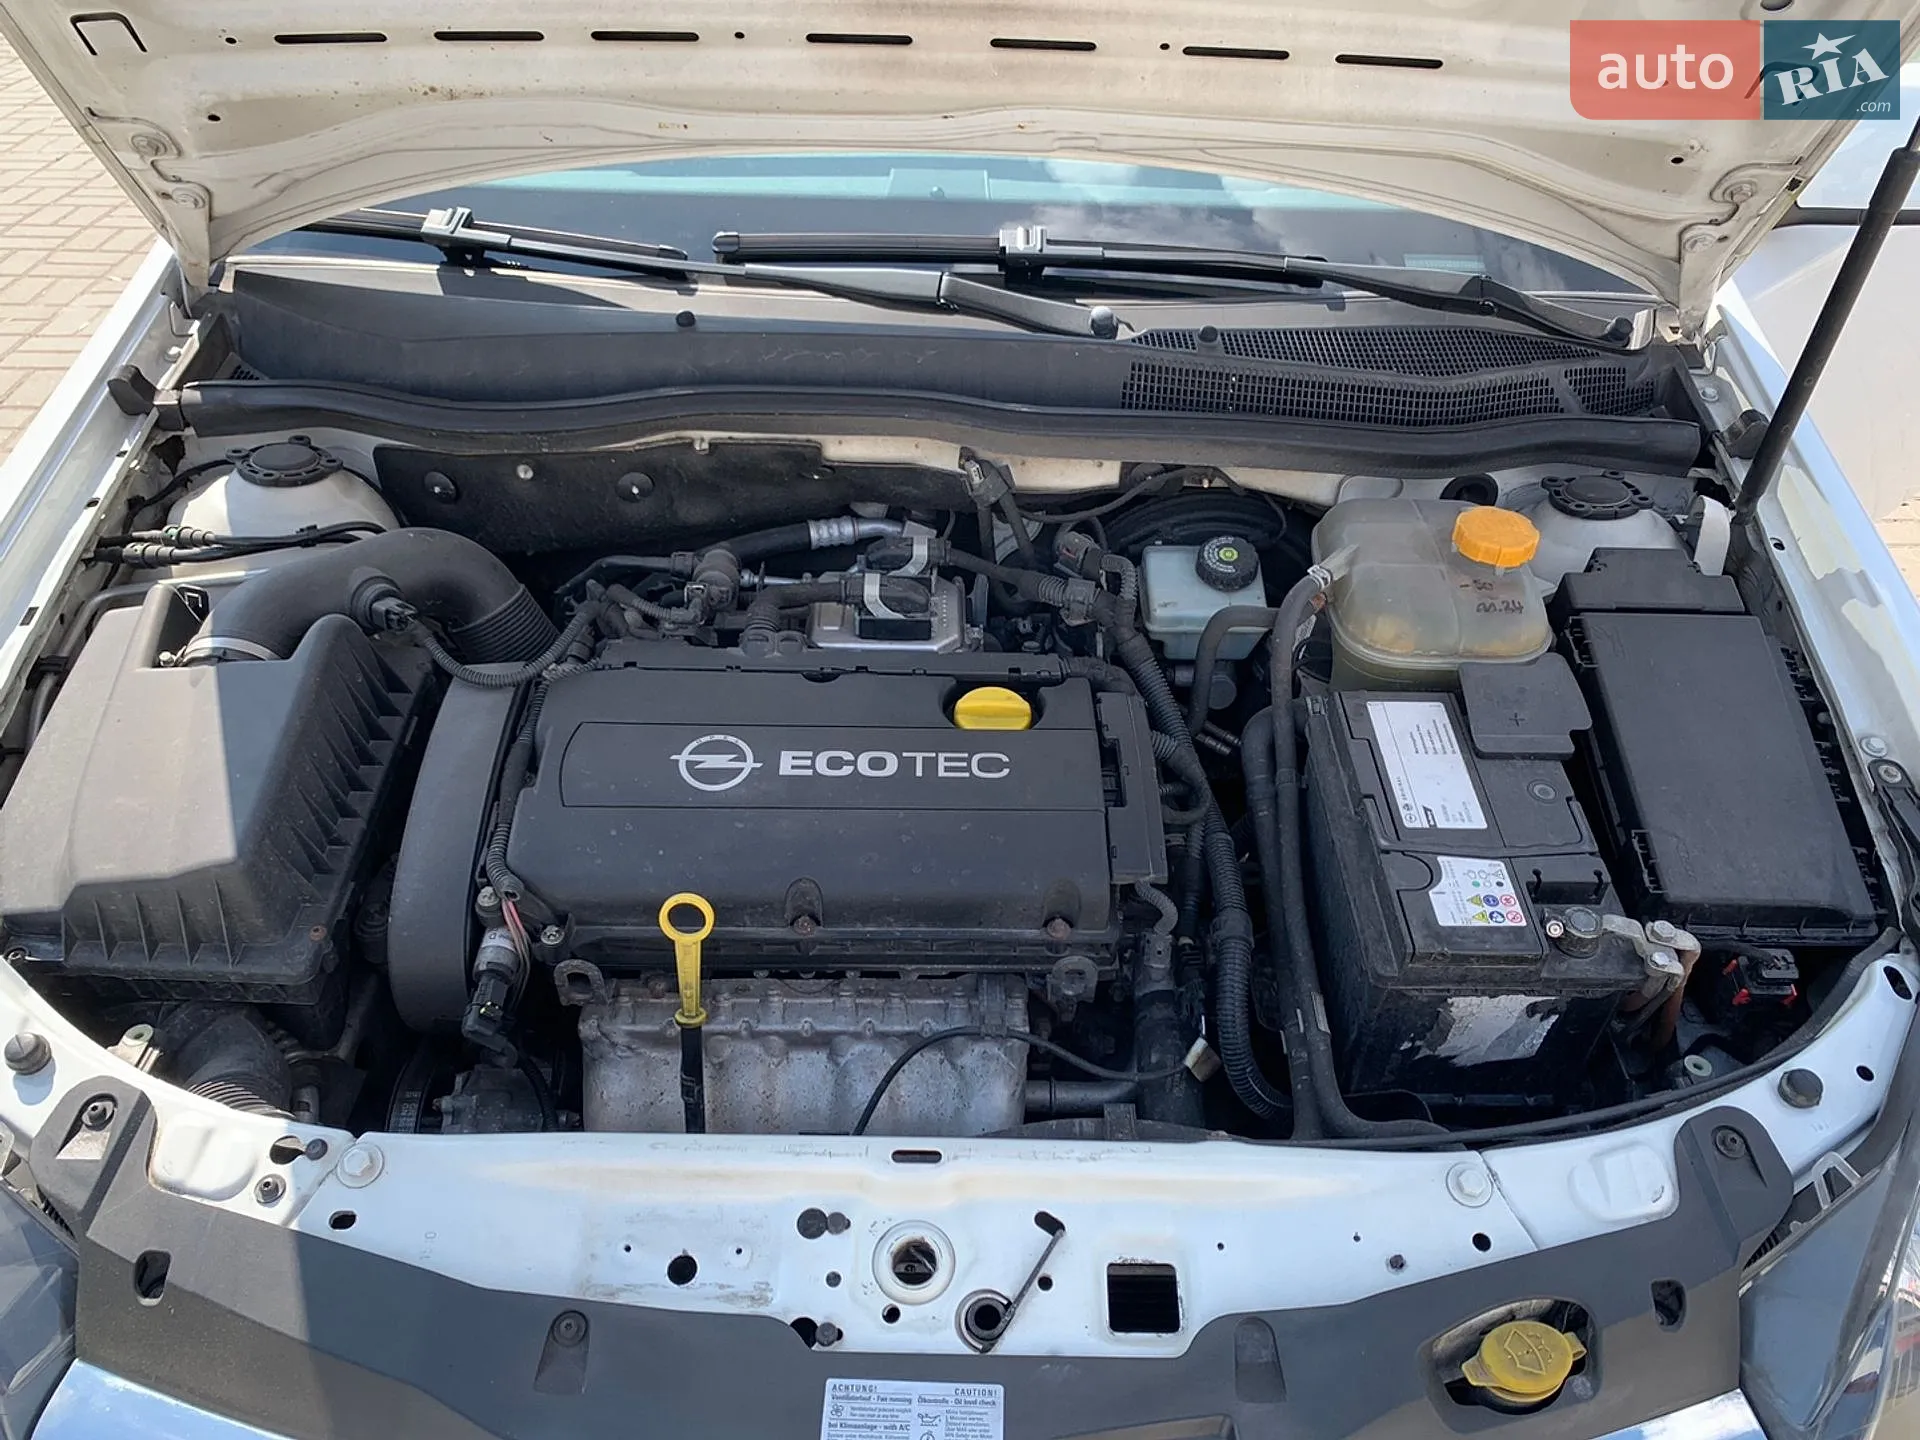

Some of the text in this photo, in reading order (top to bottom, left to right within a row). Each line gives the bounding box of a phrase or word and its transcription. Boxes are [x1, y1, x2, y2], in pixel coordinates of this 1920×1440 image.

[778, 750, 1011, 779] ECOTEC
[831, 1383, 878, 1393] ACHTUNG!
[954, 1388, 998, 1396] CAUTION!
